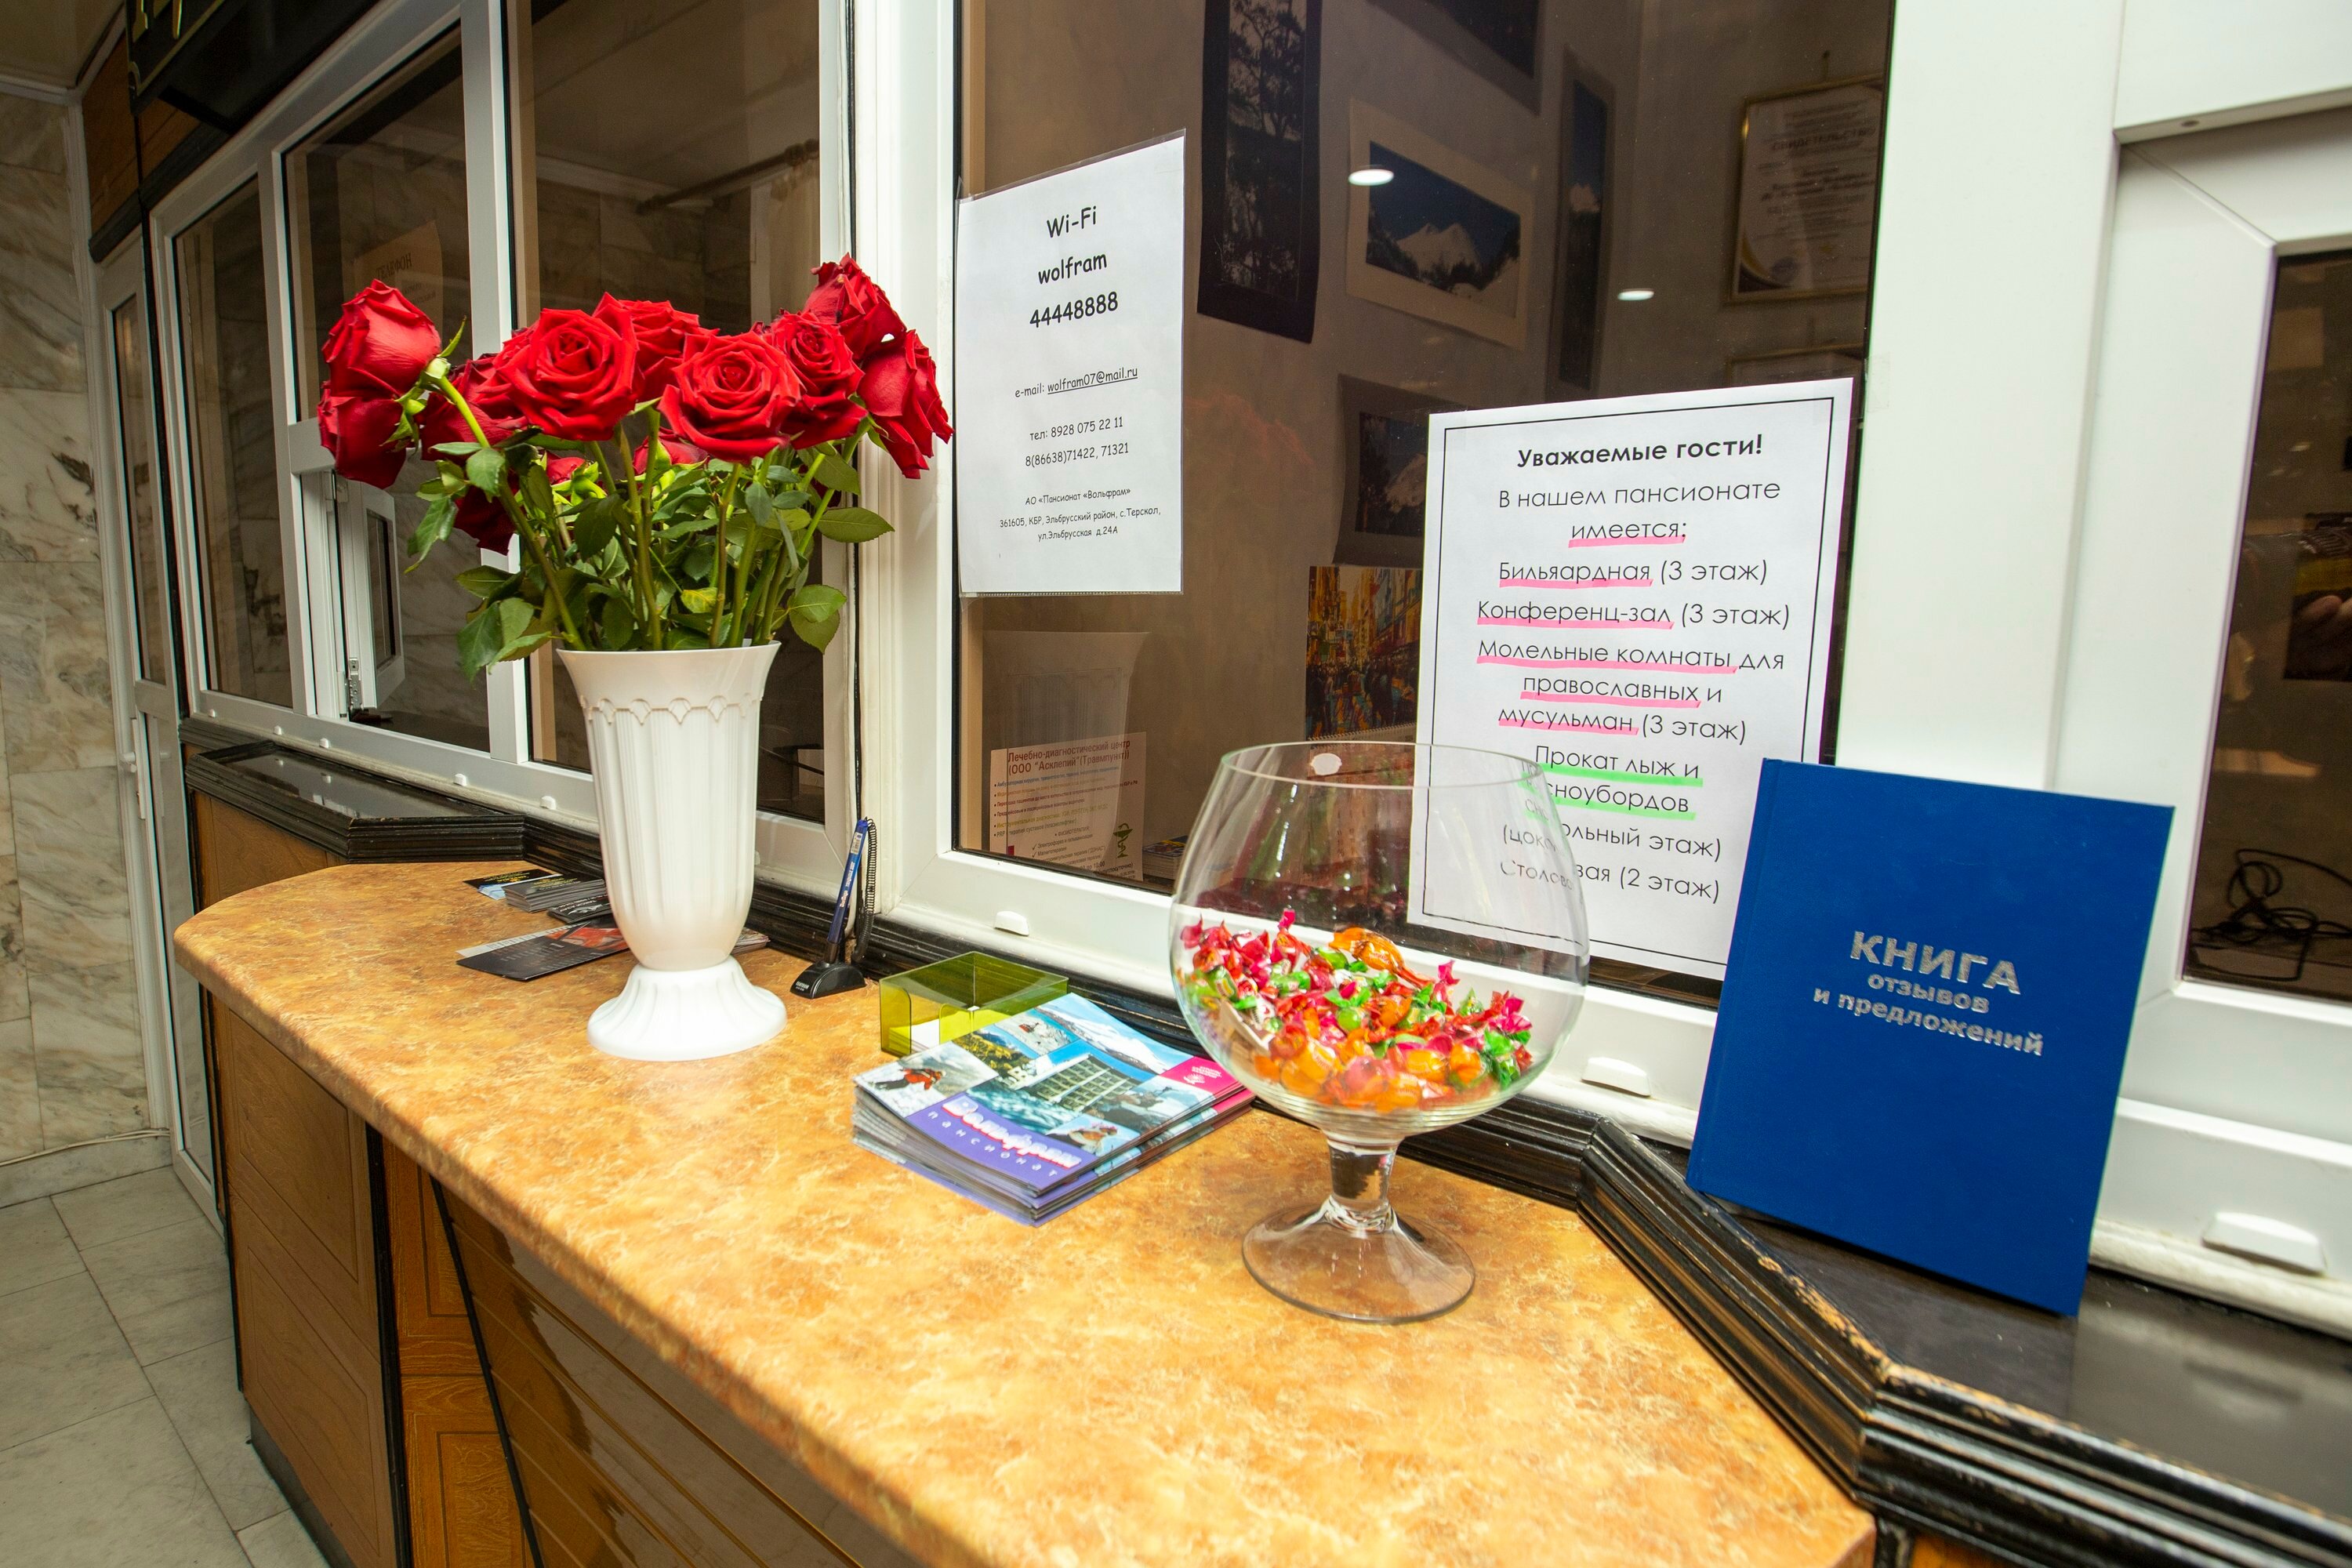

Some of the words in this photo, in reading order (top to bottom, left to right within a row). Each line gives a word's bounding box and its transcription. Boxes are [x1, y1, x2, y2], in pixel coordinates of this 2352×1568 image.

[1046, 205, 1097, 238] Wi-Fi
[1037, 253, 1108, 285] wolfram
[1029, 291, 1119, 328] 44448888
[1014, 383, 1044, 398] e-mail:
[1047, 367, 1138, 395] wolfram07@mail.ru
[1029, 431, 1047, 441] тел:
[1051, 423, 1075, 438] 8928
[1076, 420, 1096, 434] 075
[1098, 418, 1111, 430] 22
[1114, 416, 1123, 428] 11
[1025, 447, 1098, 468] 8(86638)71422,
[1101, 442, 1129, 457] 71321
[1517, 445, 1668, 468] Уважаемые
[1676, 434, 1762, 459] гости!
[1025, 496, 1037, 506] АО
[1038, 493, 1081, 503] «Пансионат
[1083, 488, 1131, 499] «Вольфрам»
[1499, 490, 1510, 508] В
[1518, 490, 1606, 507] нашем
[1615, 483, 1780, 504] пансионате
[1000, 517, 1027, 528] 361605,
[1029, 516, 1044, 525] КБР,
[1045, 511, 1091, 524] Эльбрусский
[1093, 510, 1117, 522] район,
[1572, 522, 1686, 539] имеется:
[1037, 529, 1092, 543] ул.Эльбрусская
[1499, 562, 1650, 584] Бильярдная
[1661, 560, 1682, 586] (3
[1691, 559, 1767, 586] этаж)
[1478, 601, 1671, 624] Конференц-зал
[1682, 603, 1704, 628] (3
[1712, 604, 1789, 630] этаж)
[1479, 640, 1609, 662] Молельные
[1617, 648, 1730, 667] комнаты
[1738, 653, 1784, 670] для
[1523, 677, 1699, 702] православных
[1707, 688, 1722, 703] и
[1498, 709, 1632, 731] мусульман
[1642, 713, 1663, 738] (3
[1671, 720, 1746, 746] этаж)
[1007, 742, 1109, 763] Лечебно-диагностический
[1535, 745, 1619, 771] Прокат
[1625, 759, 1675, 777] лыж
[1684, 764, 1699, 779] и
[1008, 762, 1032, 776] (ООО
[1649, 835, 1721, 863] этаж)
[1621, 866, 1640, 890] (2
[1648, 876, 1719, 905] этаж)
[1850, 931, 2021, 995] КНИГА
[1867, 974, 1990, 1014] отзывов
[1813, 988, 1831, 1004] и
[1838, 993, 2043, 1057] предложений
